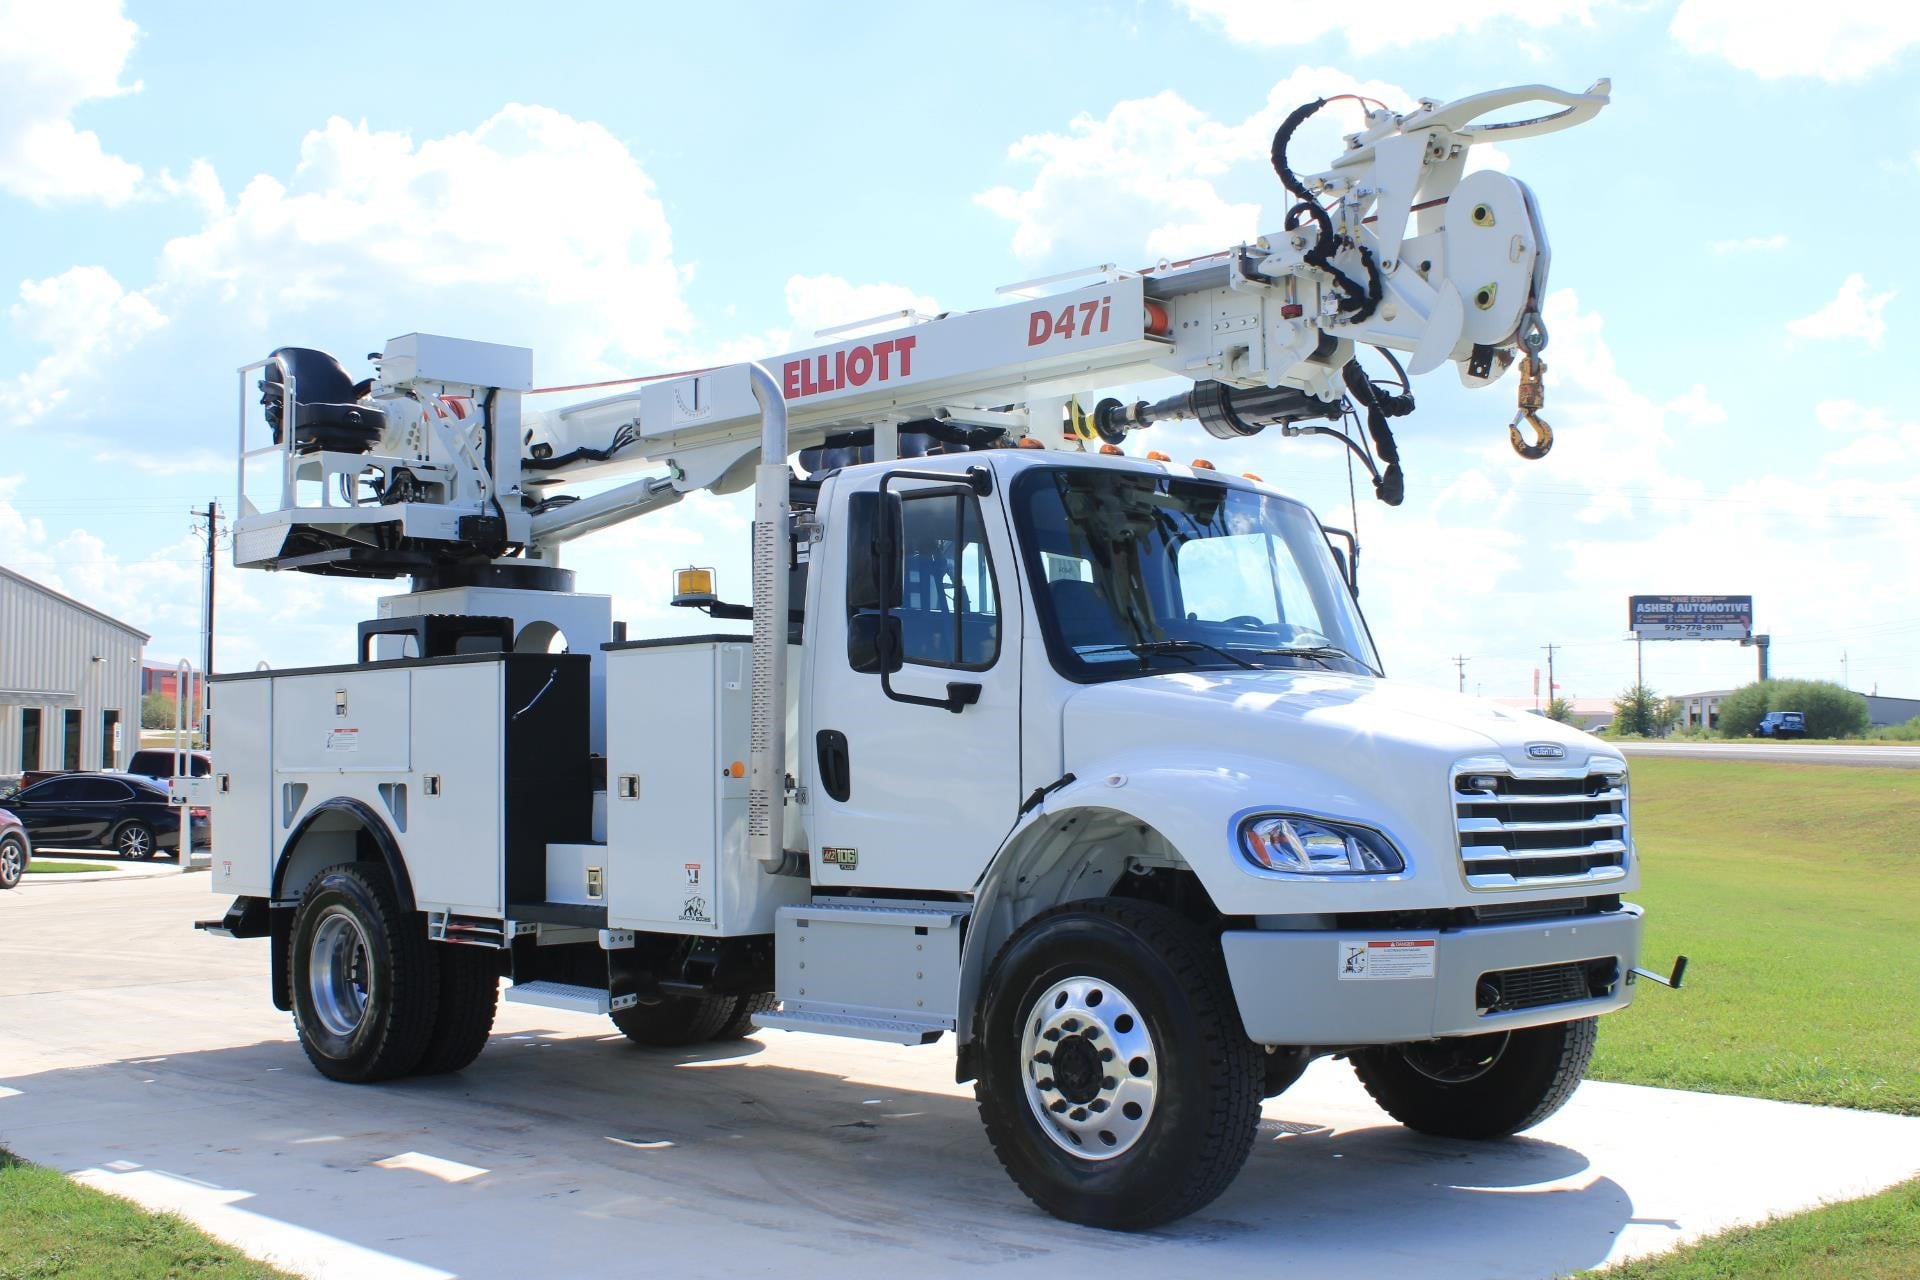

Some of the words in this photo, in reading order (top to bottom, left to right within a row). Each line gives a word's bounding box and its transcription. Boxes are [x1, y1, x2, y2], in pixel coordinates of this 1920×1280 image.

[1028, 296, 1111, 346] D47i
[783, 335, 916, 400] ELLIOTT
[1636, 603, 1674, 613] ASHER
[1676, 603, 1750, 613] AUTOMOTIVE
[836, 849, 856, 863] 106
